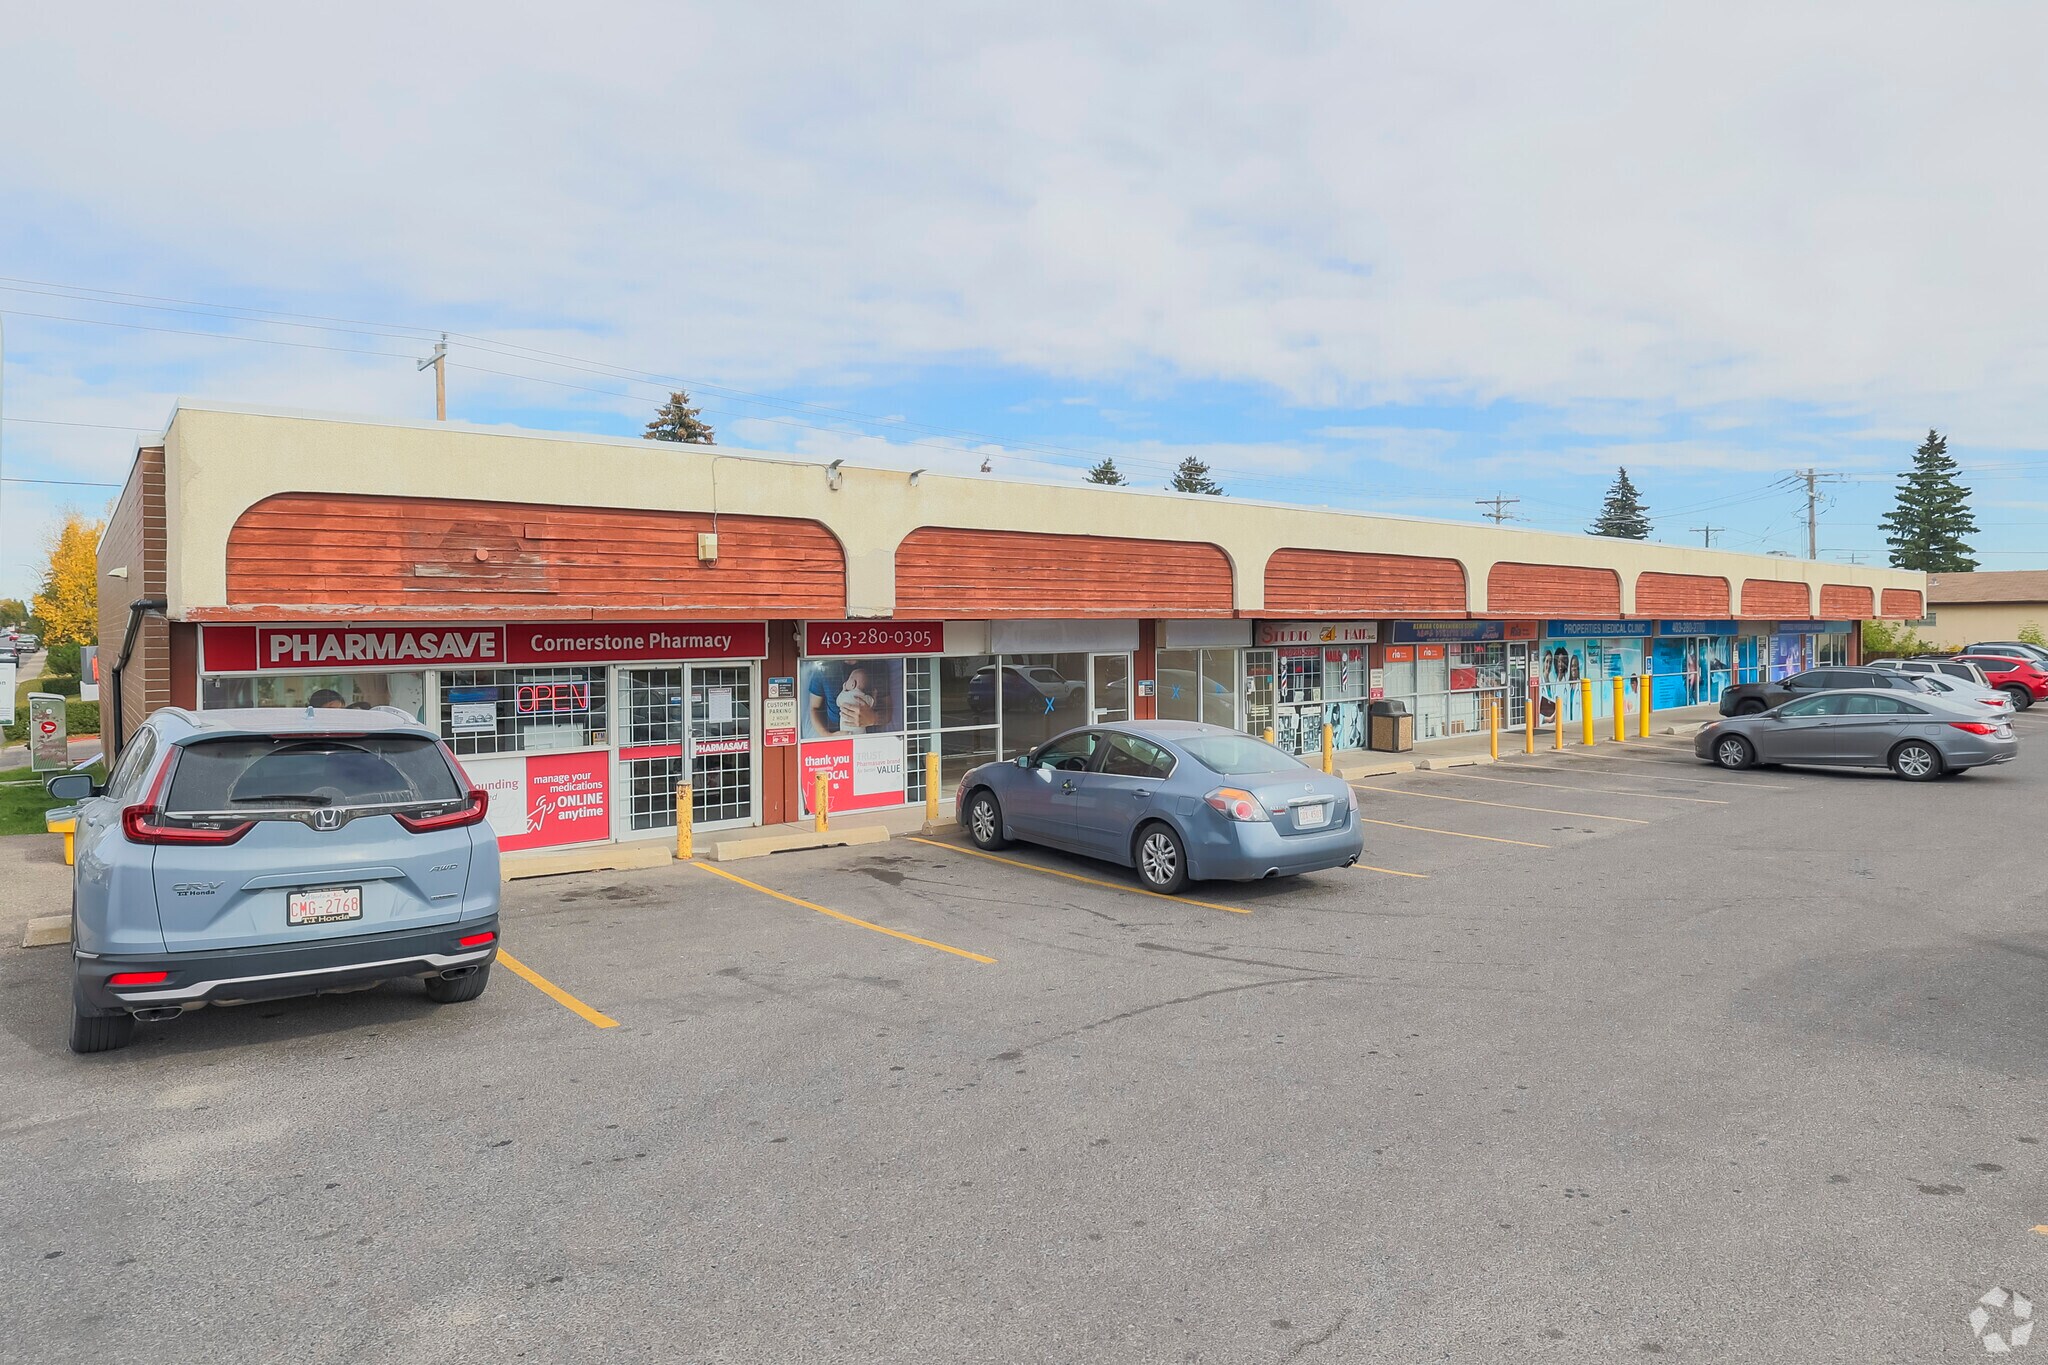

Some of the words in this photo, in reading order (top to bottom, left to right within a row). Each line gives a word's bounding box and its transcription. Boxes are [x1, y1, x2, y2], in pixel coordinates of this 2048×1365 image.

[1262, 625, 1312, 644] STUDIO
[1344, 628, 1367, 640] HAIR
[1564, 623, 1602, 634] PROPERTIES
[1602, 623, 1627, 634] MEDICAL
[1628, 623, 1646, 633] CLINIC
[531, 634, 645, 652] Cornerstone
[649, 632, 732, 652] Pharmacy
[821, 628, 932, 648] 403-280-0305
[270, 632, 495, 662] PHARMASAVE
[518, 684, 587, 712] OPEN
[696, 742, 748, 753] PHARMASAVE
[805, 754, 831, 767] thank
[833, 755, 850, 767] you
[857, 751, 882, 760] TRUST
[827, 770, 849, 780] OCAL
[876, 765, 901, 774] VALUE
[534, 774, 570, 785] manage
[571, 772, 592, 783] your
[550, 781, 603, 793] medications
[557, 792, 604, 808] ONLINE
[558, 806, 604, 822] anytime
[429, 863, 458, 872] AWD
[172, 880, 226, 891] CR-V
[291, 897, 359, 917] CMG-2768
[318, 914, 350, 923] Honda
